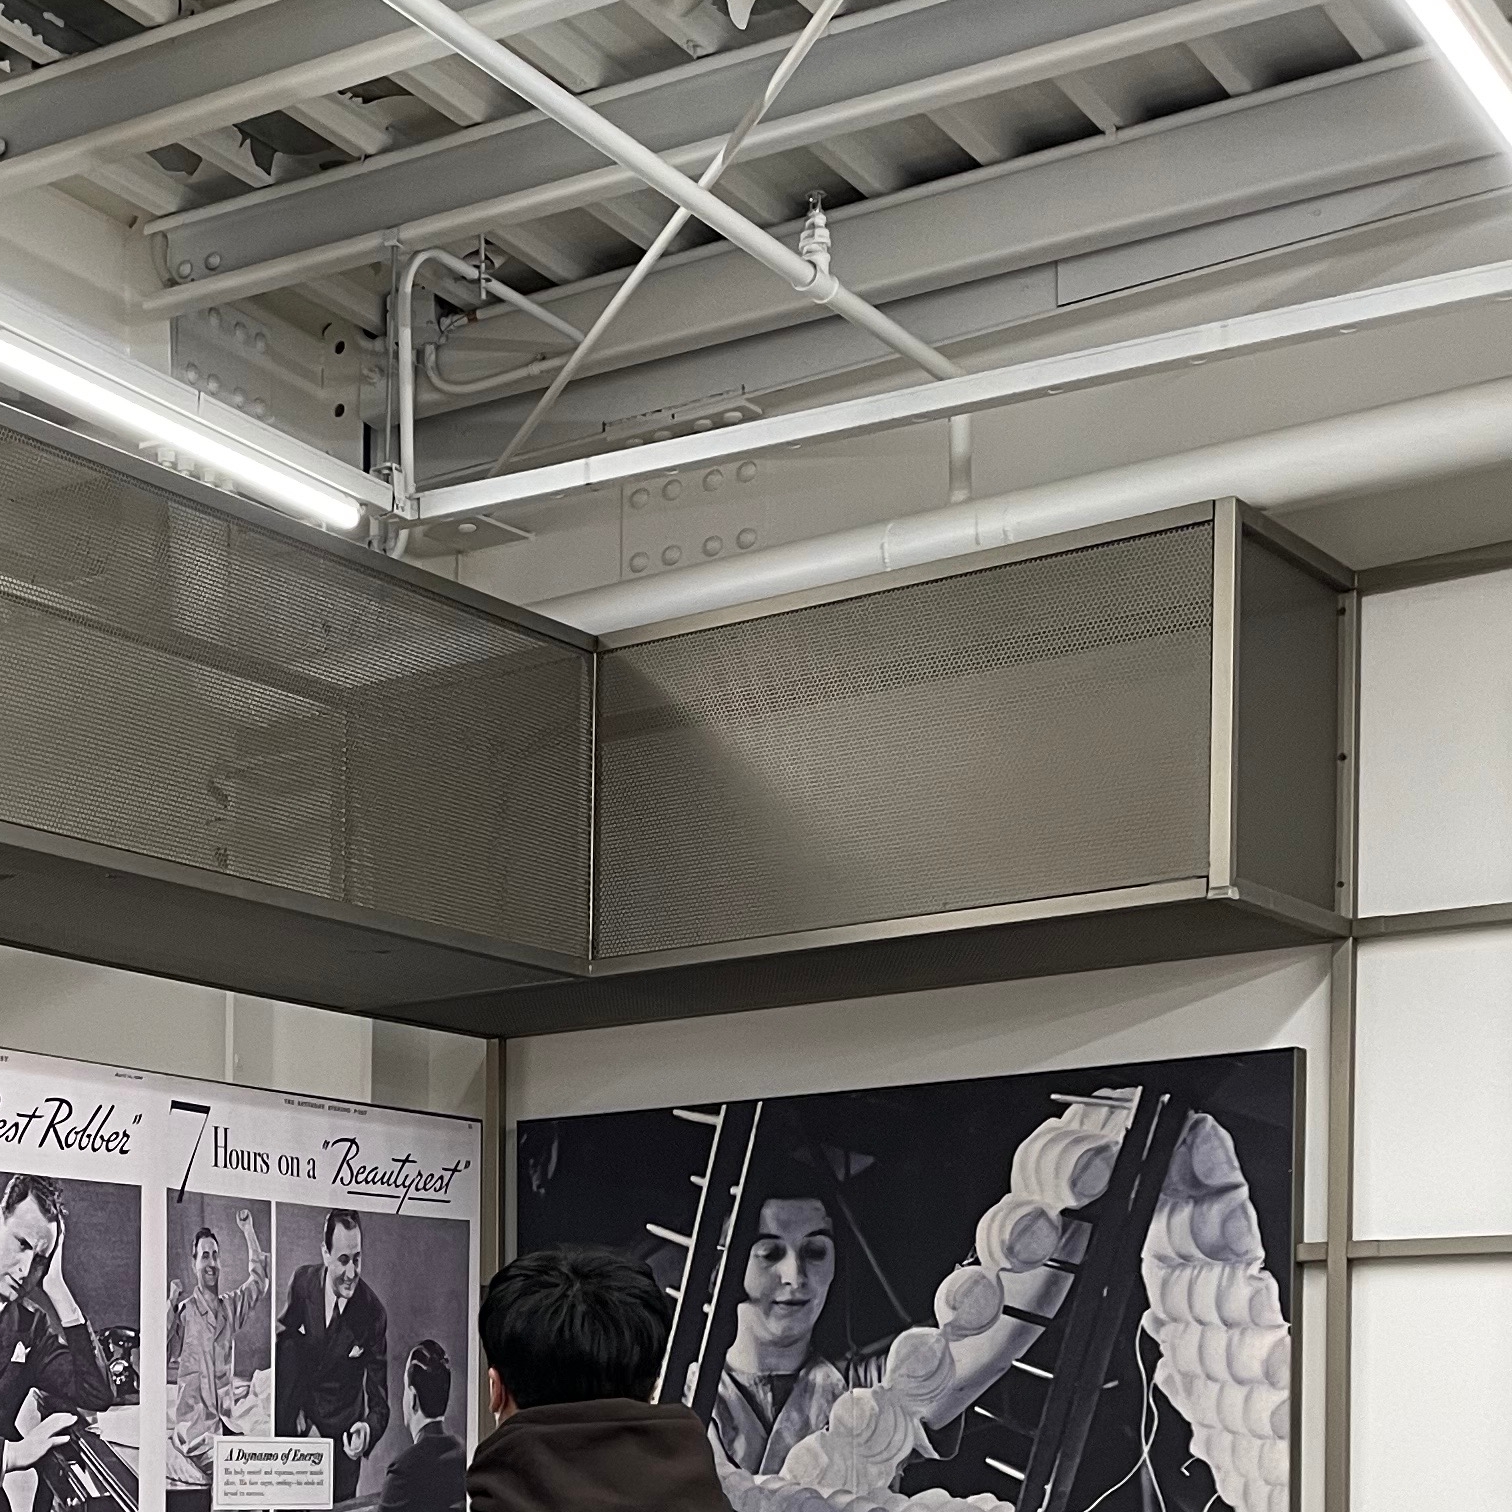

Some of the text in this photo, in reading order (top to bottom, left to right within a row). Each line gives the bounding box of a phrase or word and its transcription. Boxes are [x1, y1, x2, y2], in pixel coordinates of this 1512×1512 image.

[169, 1100, 471, 1214] 7 Hours on a "Beautyrest"
[224, 1448, 324, 1465] A Dynamo of Energy
